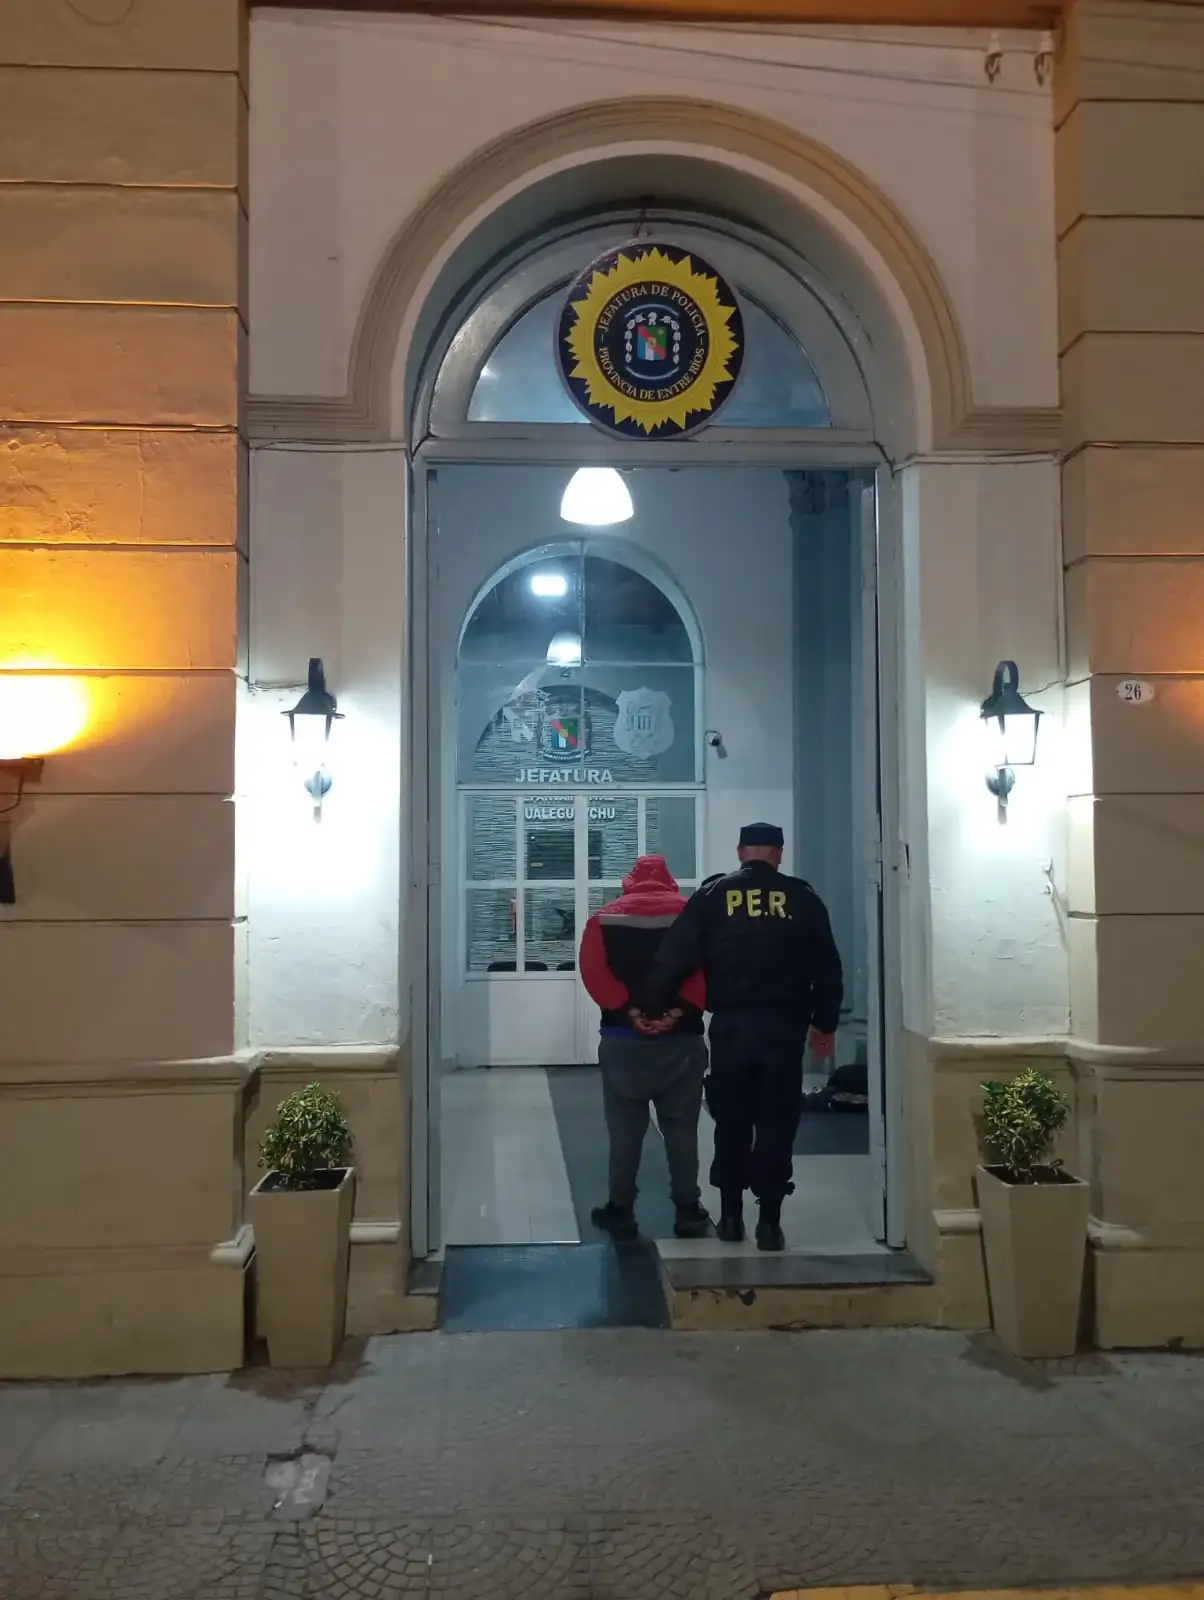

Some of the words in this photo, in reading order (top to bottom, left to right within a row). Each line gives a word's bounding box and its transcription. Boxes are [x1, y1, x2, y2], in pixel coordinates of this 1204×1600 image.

[598, 284, 648, 333] JEFATURA
[651, 284, 669, 297] DE
[598, 347, 638, 398] PROVINCIA
[639, 389, 656, 400] DE
[657, 374, 694, 399] ENTRE
[1124, 683, 1142, 701] 26
[515, 768, 613, 784] JEFATURA
